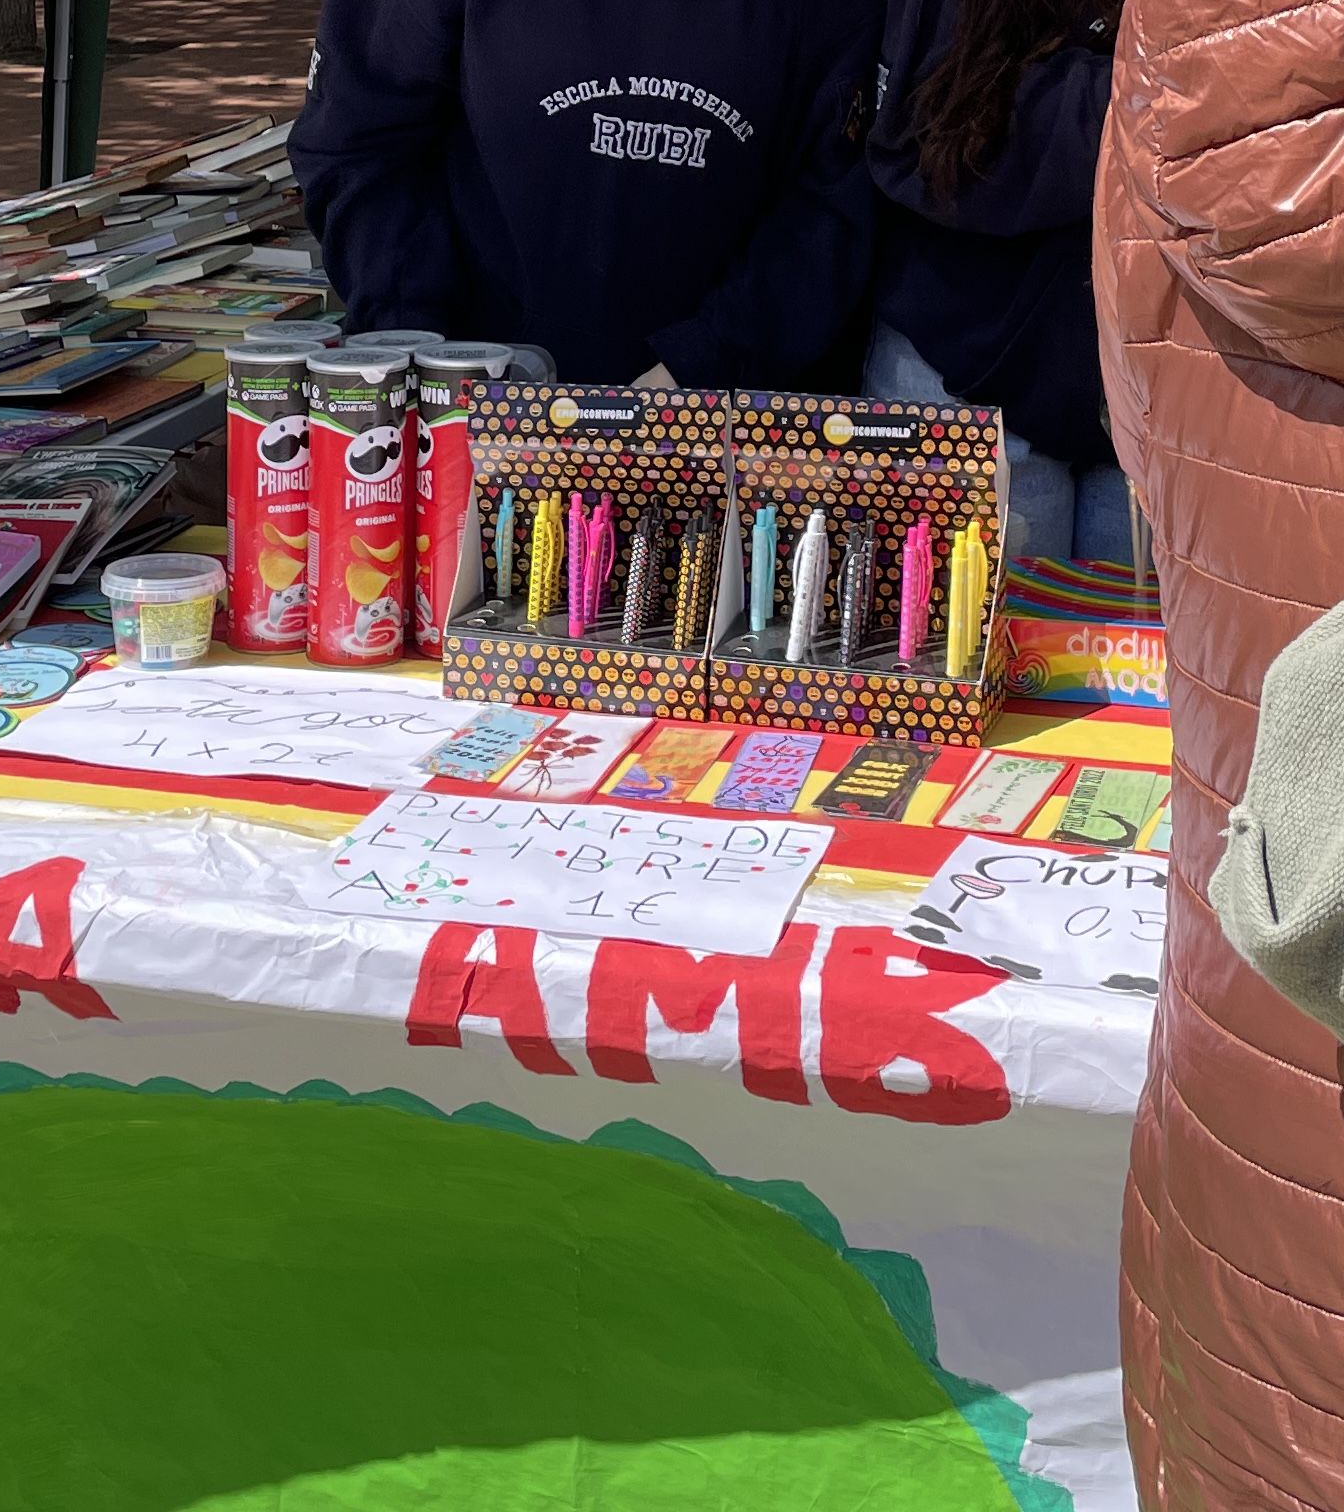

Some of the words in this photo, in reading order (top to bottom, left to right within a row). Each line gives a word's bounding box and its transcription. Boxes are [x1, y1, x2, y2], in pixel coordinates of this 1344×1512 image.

[539, 77, 623, 116] ESCOLA
[629, 76, 754, 143] MONTSERRAT
[590, 112, 711, 169] RUBI
[389, 391, 407, 408] WI
[420, 385, 450, 405] WIN
[268, 502, 309, 514] ORIGINA
[345, 472, 403, 511] PRINGLES
[355, 513, 397, 527] ORIGINAL
[123, 729, 168, 758] 4
[444, 748, 496, 763] 2022
[736, 775, 798, 788] 2022
[1066, 798, 1092, 816] SANT
[1079, 769, 1106, 784] 2022
[399, 792, 693, 847] PUNTS
[721, 825, 821, 858] DE
[367, 822, 744, 883] LLIBRE
[326, 869, 397, 901] A
[565, 890, 676, 926] 1€
[406, 921, 1013, 1126] AMB
